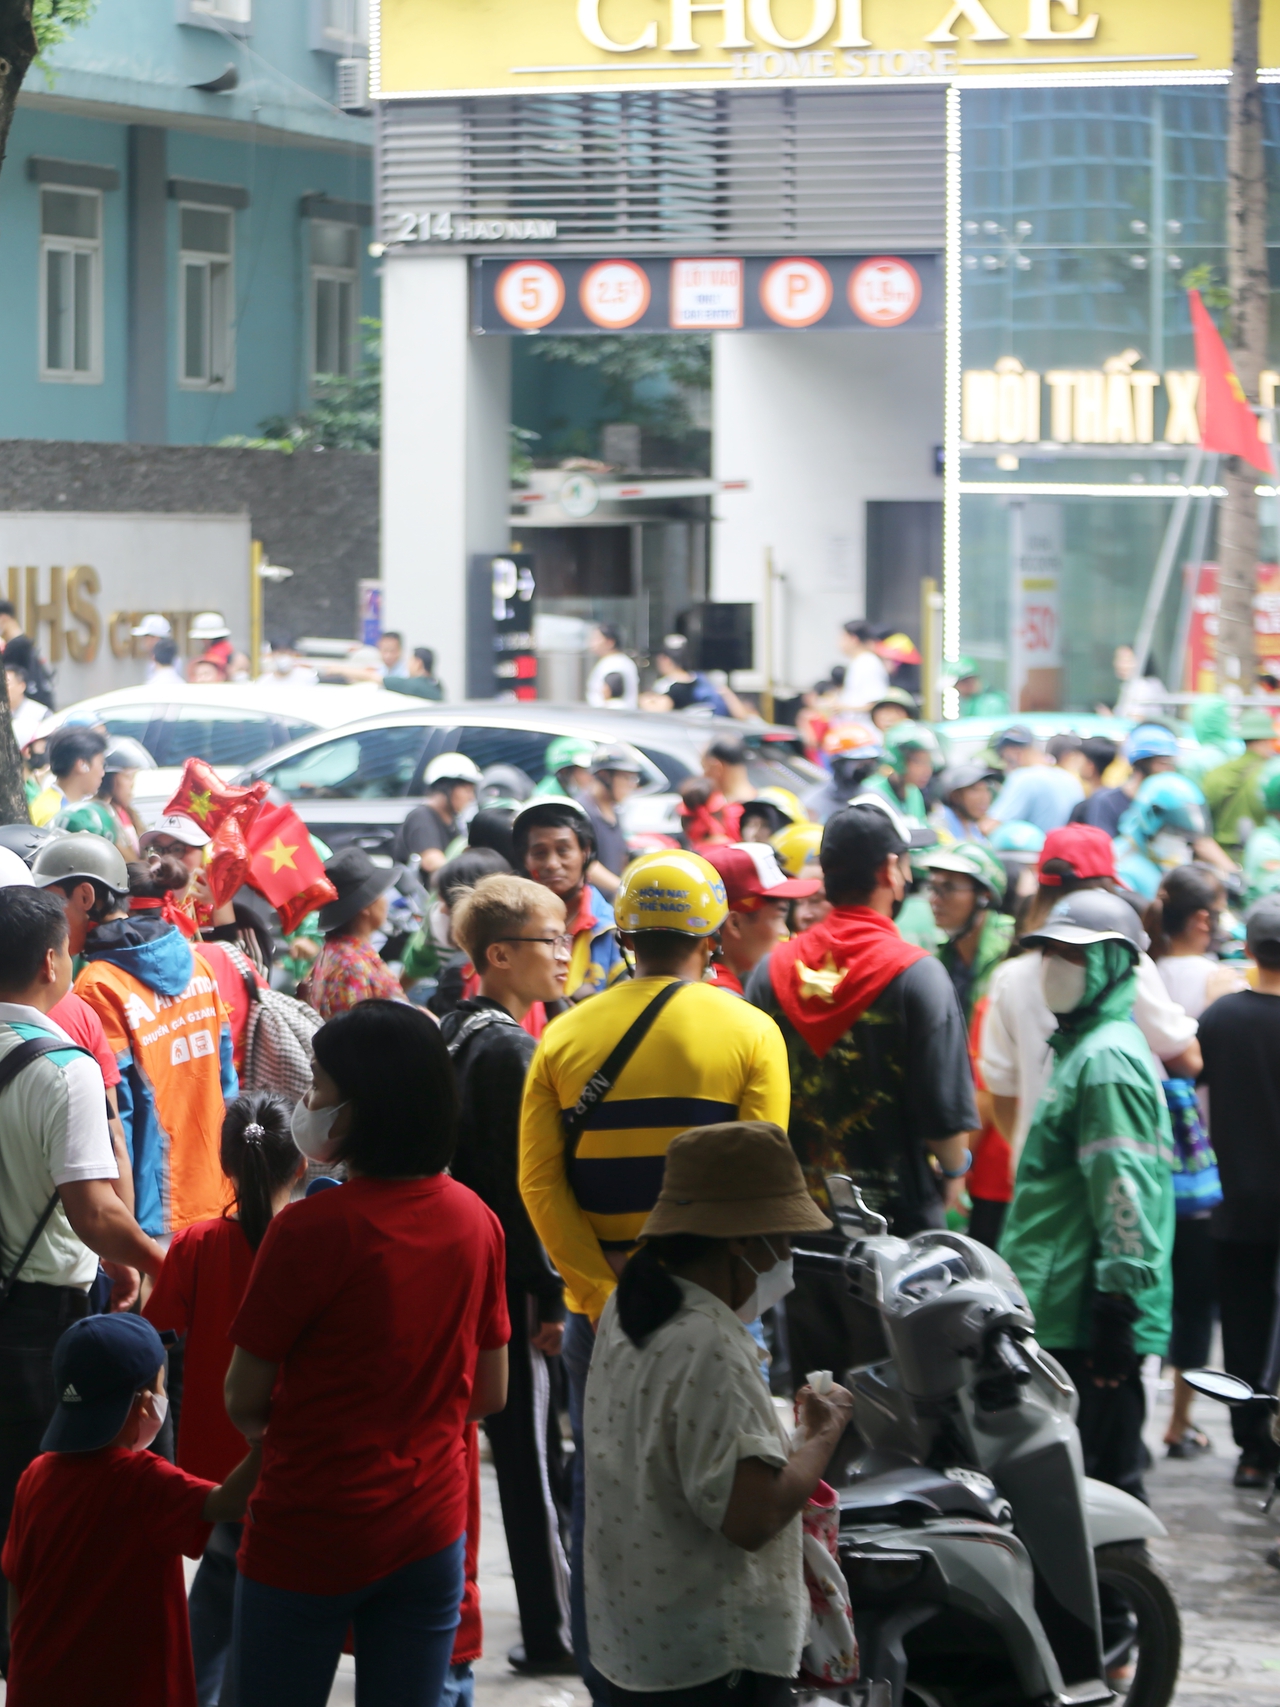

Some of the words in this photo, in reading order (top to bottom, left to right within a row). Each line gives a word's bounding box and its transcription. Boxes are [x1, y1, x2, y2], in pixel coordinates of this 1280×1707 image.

[732, 51, 837, 80] HOME
[842, 48, 958, 77] STORE
[396, 211, 453, 242] 214
[506, 219, 558, 240] NAM
[518, 276, 542, 313] 5
[785, 273, 809, 310] P
[1044, 349, 1161, 444] THẤT
[1163, 370, 1205, 444] X
[638, 900, 659, 912] THẾ
[660, 902, 692, 913] NÀO?
[639, 886, 665, 899] HÔM
[667, 889, 690, 899] NAY
